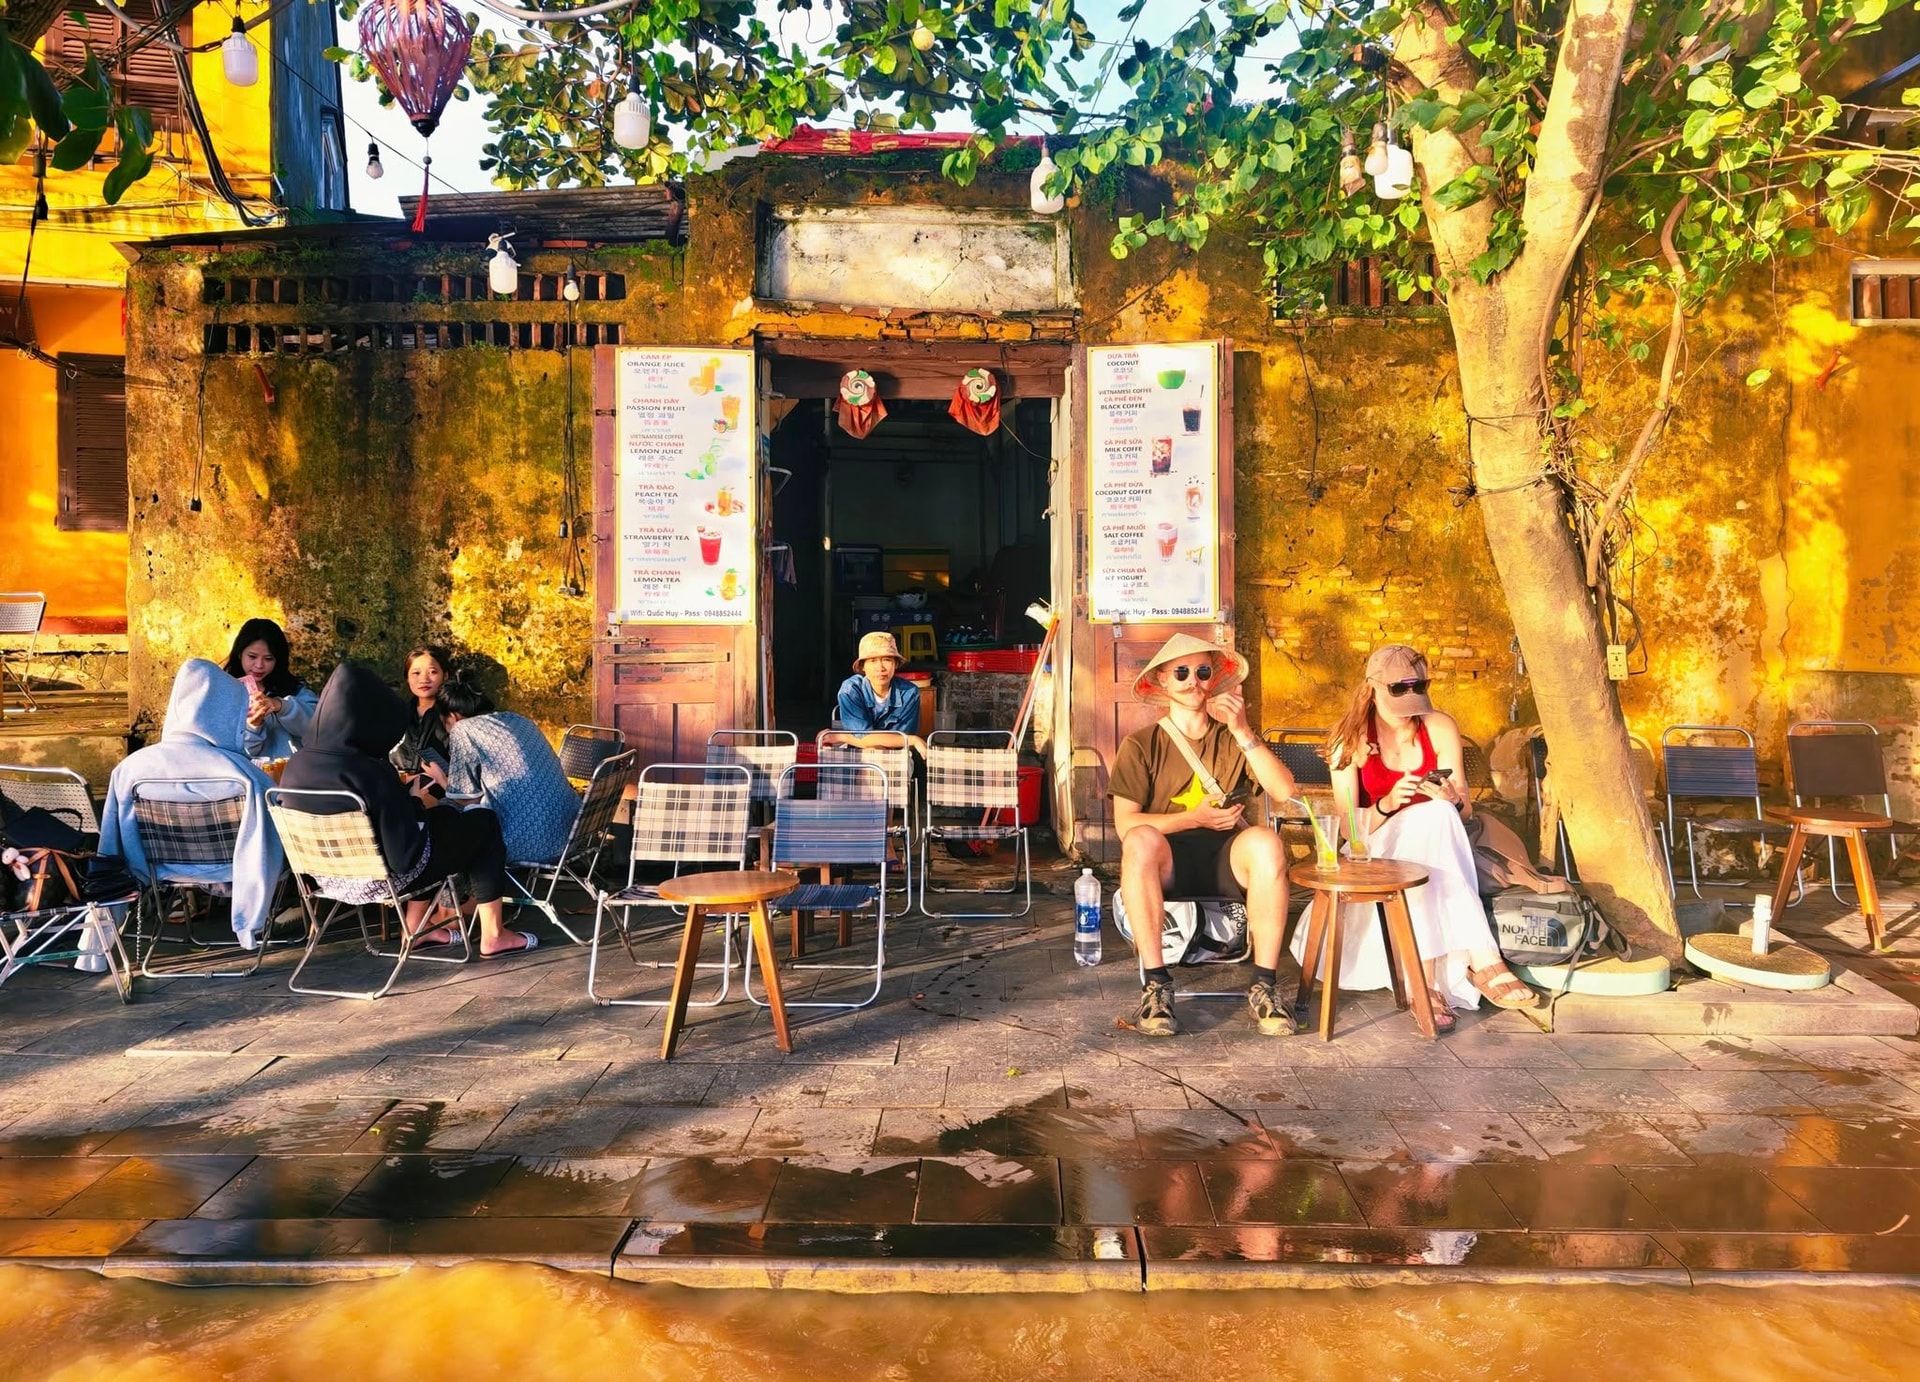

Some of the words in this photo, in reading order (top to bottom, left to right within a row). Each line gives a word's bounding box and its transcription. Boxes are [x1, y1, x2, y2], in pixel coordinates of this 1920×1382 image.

[665, 609, 679, 618] Huy
[704, 610, 743, 618] 0948852444
[1132, 608, 1147, 617] Huy
[1151, 607, 1170, 616] Pass:
[1521, 914, 1549, 926] THE
[1502, 924, 1547, 936] NORTH
[1514, 935, 1547, 946] FACE
